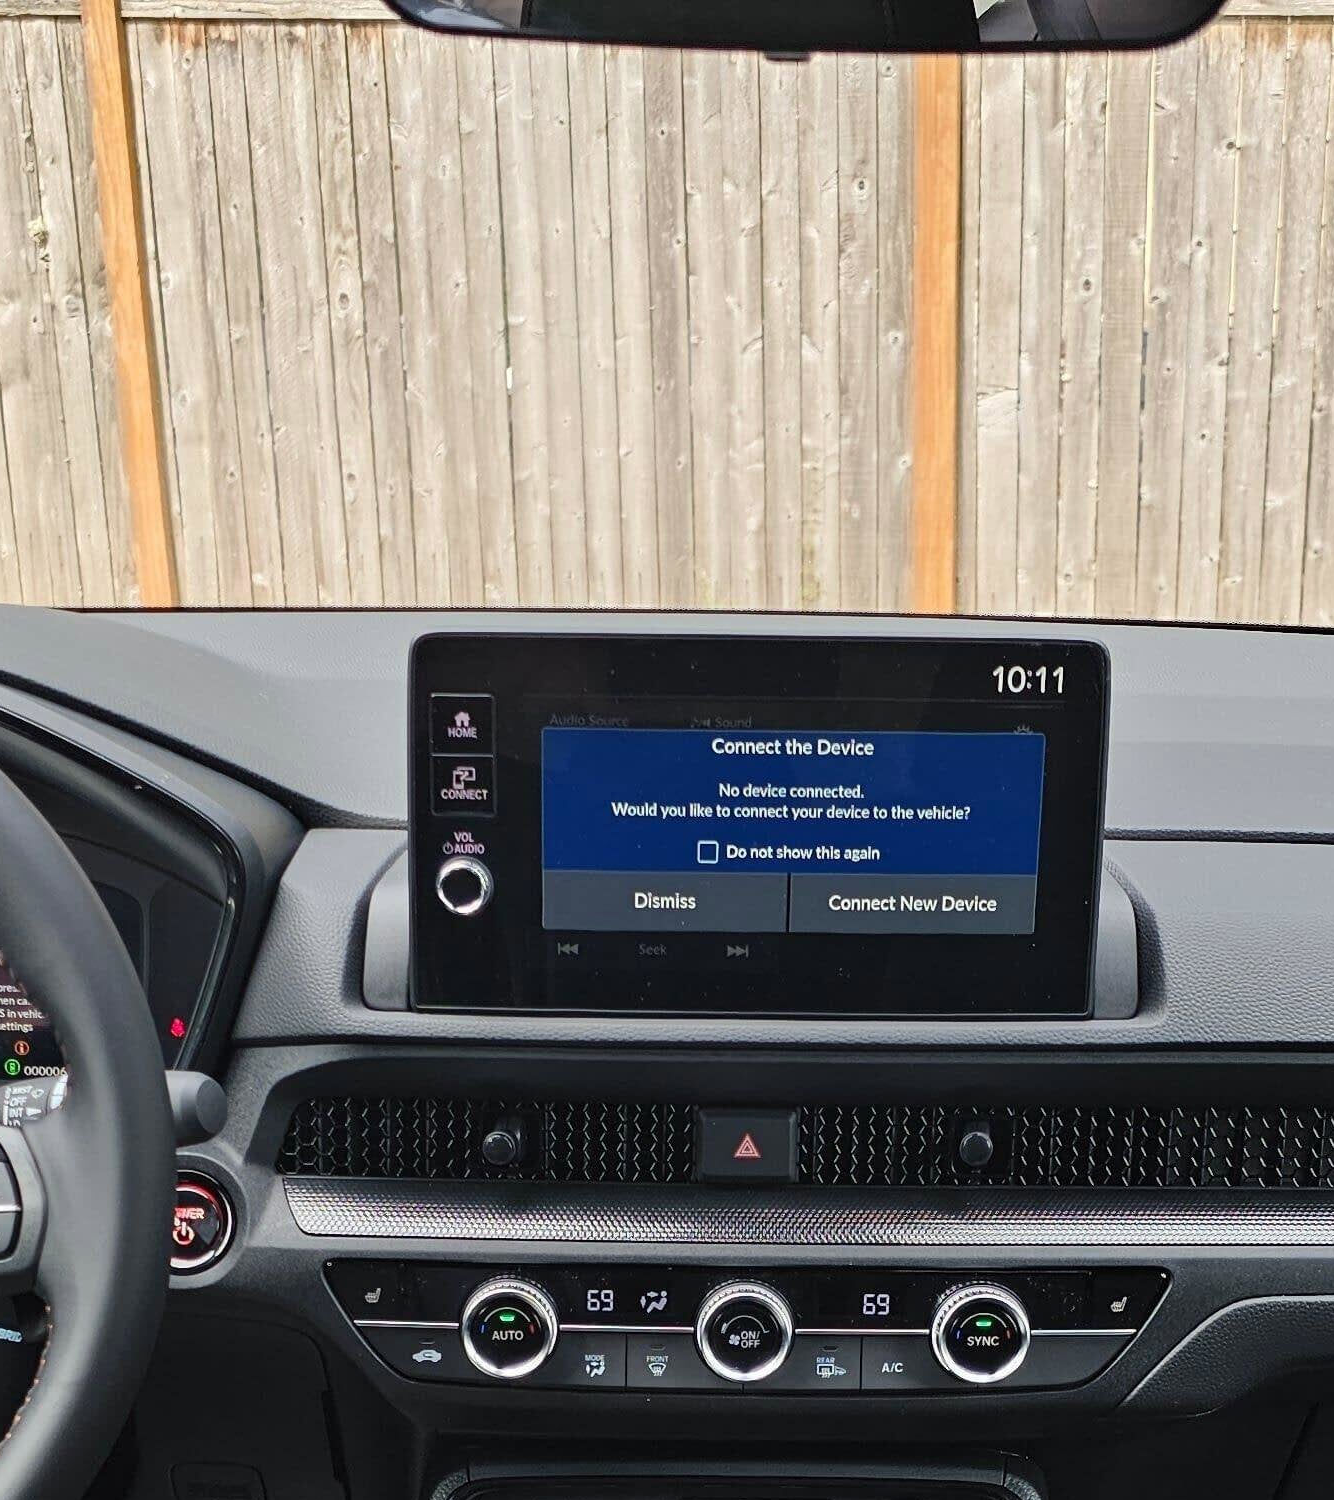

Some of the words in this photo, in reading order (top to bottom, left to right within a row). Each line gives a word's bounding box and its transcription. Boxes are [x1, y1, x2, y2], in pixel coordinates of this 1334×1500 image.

[992, 665, 1064, 694] 10:11
[588, 714, 629, 727] Source
[714, 716, 752, 728] Sound
[447, 726, 477, 739] HOME
[711, 738, 782, 755] Connect
[784, 738, 813, 756] the
[817, 738, 875, 756] Device
[440, 788, 489, 801] CONNECT
[719, 783, 740, 798] No
[742, 783, 787, 798] device
[789, 784, 865, 799] connected.
[610, 801, 658, 818] Would
[659, 805, 687, 820] you
[689, 802, 714, 818] like
[715, 804, 731, 819] to
[733, 805, 789, 819] connect
[791, 806, 824, 821] your
[826, 804, 871, 819] device
[872, 806, 888, 820] to
[890, 805, 914, 820] the
[916, 805, 971, 821] vehicle?
[453, 831, 475, 843] VOL
[453, 843, 486, 855] AUDIO
[726, 844, 748, 860] Do
[750, 845, 774, 860] not
[776, 844, 814, 861] show
[816, 845, 841, 861] this
[843, 846, 881, 863] again
[634, 892, 697, 910] Dismiss
[827, 894, 897, 912] Connect
[900, 895, 938, 912] New
[942, 895, 998, 913] Device
[638, 943, 668, 957] Seek
[6, 1007, 17, 1019] in
[9, 1107, 24, 1118] INT
[586, 1289, 614, 1312] 69
[862, 1293, 891, 1316] 69
[491, 1329, 525, 1342] AUTO
[740, 1329, 761, 1341] ON/
[966, 1335, 1000, 1348] SYNC
[740, 1338, 761, 1349] OFF
[584, 1354, 605, 1362] MODE
[646, 1355, 669, 1363] FRONT
[816, 1356, 836, 1364] REAR
[881, 1361, 905, 1374] A/C
